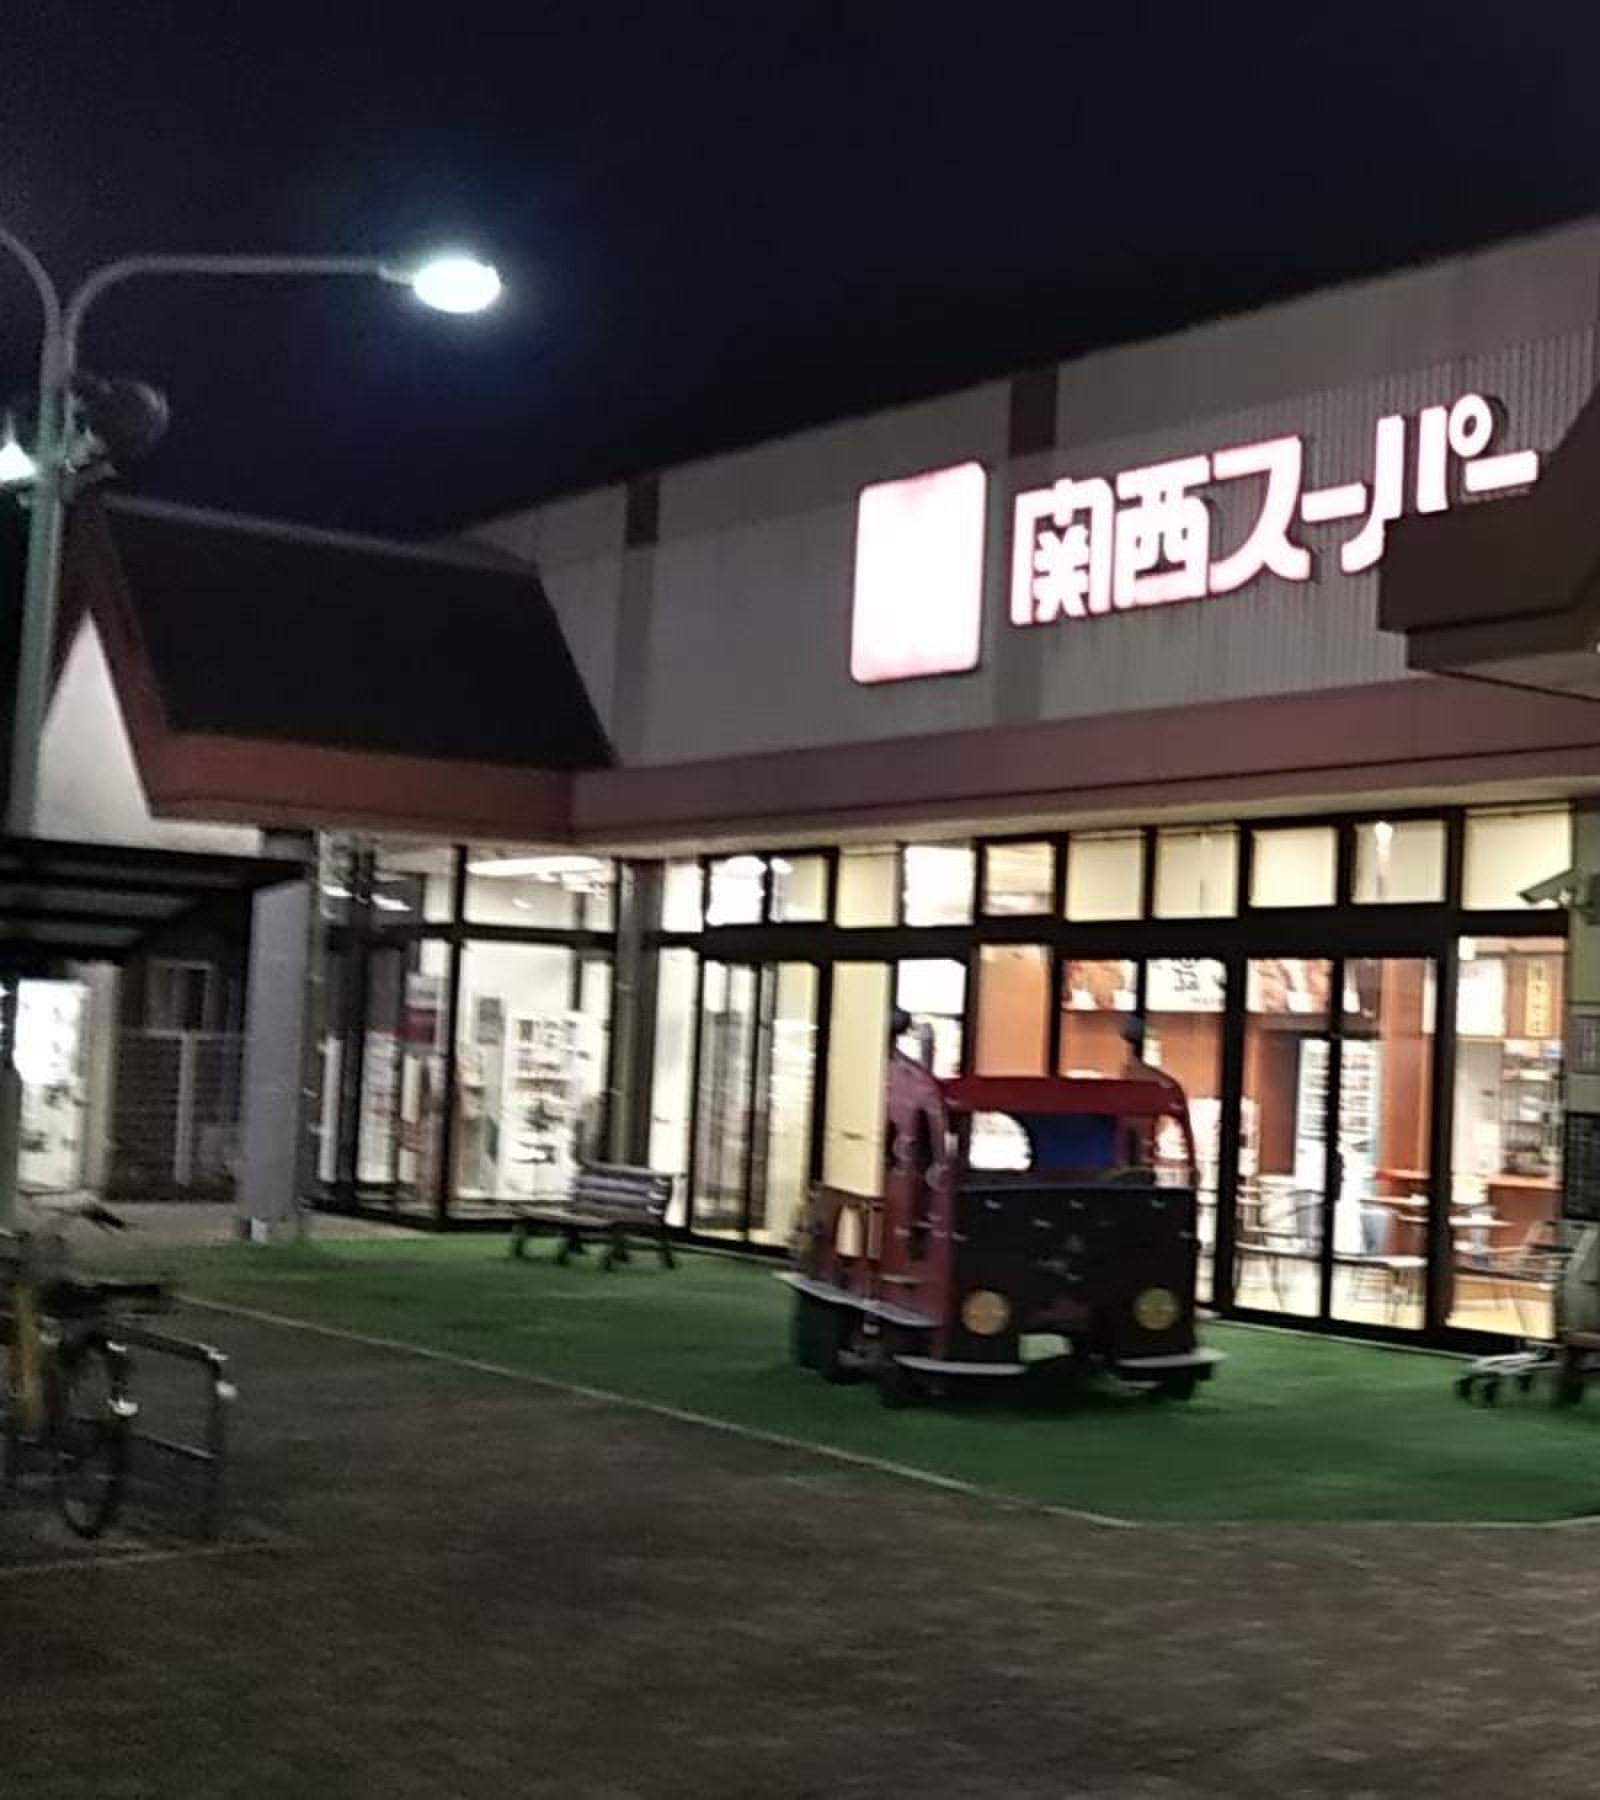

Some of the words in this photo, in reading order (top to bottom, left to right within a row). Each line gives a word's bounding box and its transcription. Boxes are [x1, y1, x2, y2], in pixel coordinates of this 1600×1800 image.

[1009, 393, 1538, 625] 関西スーパー
